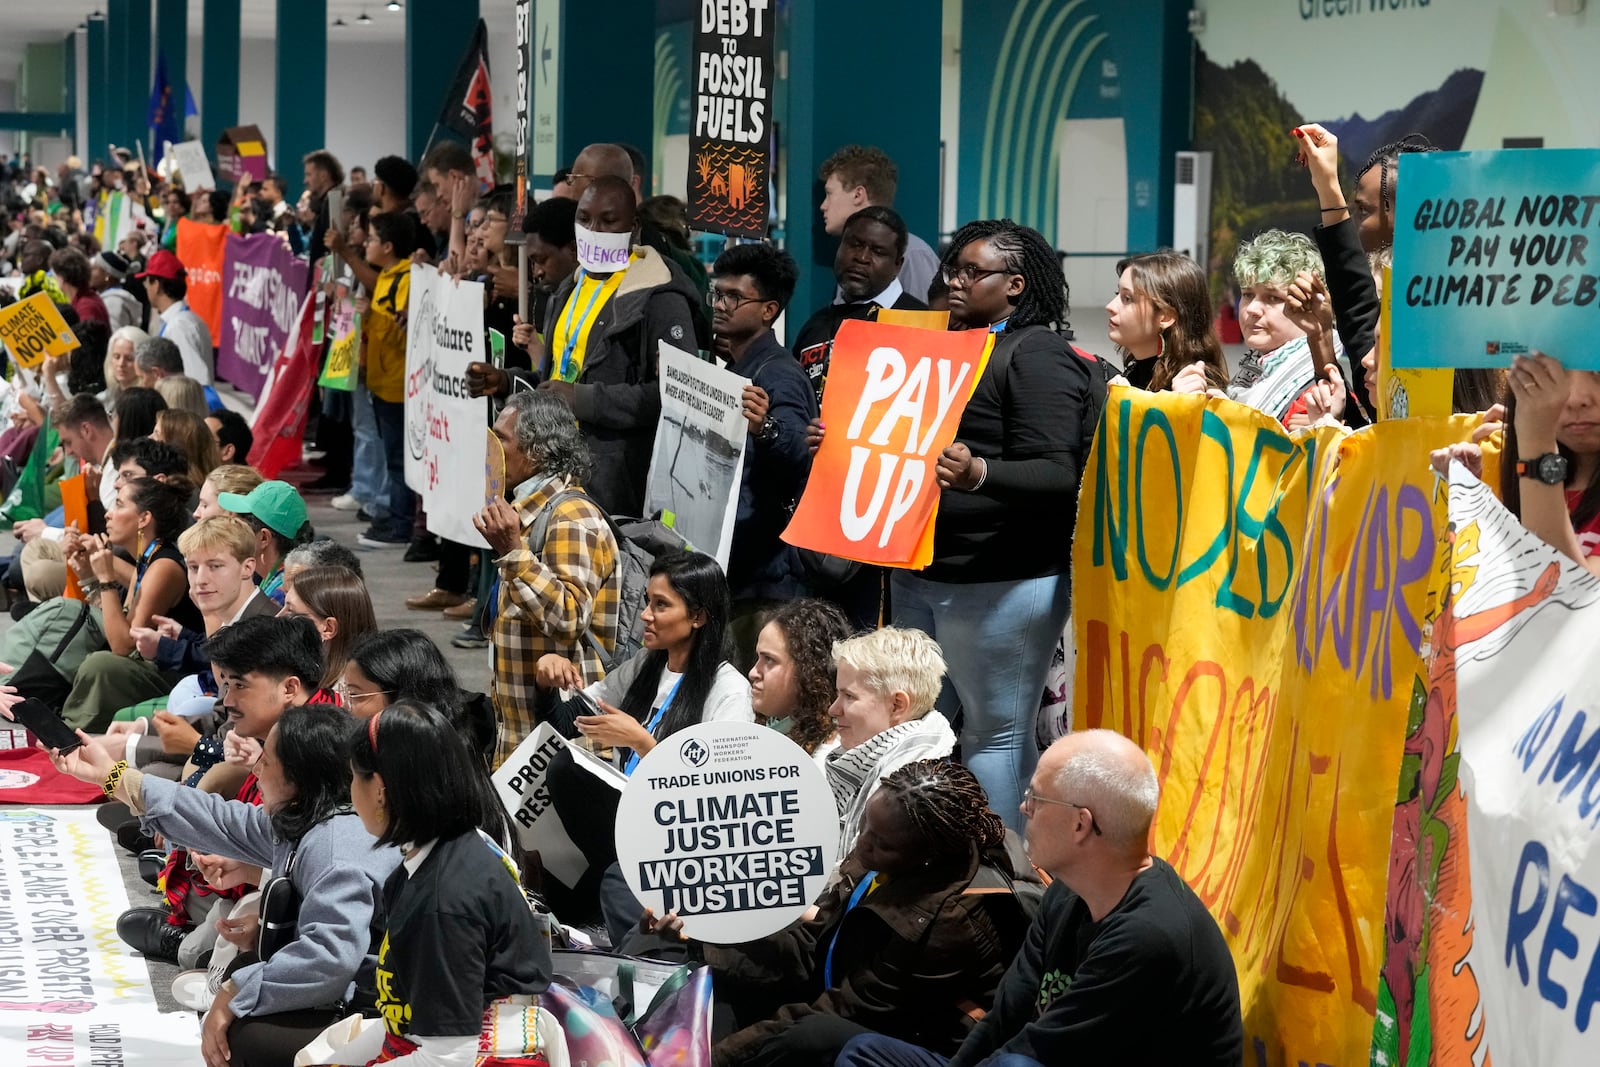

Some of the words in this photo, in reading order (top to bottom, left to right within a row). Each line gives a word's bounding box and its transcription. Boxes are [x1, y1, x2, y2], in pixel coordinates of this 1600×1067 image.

[701, 0, 768, 37] DEBT
[721, 38, 737, 55] TO
[698, 52, 766, 99] FOSSIL
[696, 95, 764, 144] FUELS
[1413, 197, 1506, 231] GLOBAL
[1514, 194, 1600, 229] NORT
[577, 238, 629, 265] SILENCED
[1447, 234, 1500, 268] PAY
[1509, 234, 1588, 267] YOUR
[1406, 273, 1521, 307] CLIMATE
[1530, 273, 1600, 308] DEB
[0, 302, 36, 337] CLIMATE
[12, 311, 45, 344] ACTION
[15, 322, 57, 362] NOW
[847, 347, 971, 456] PAY
[840, 446, 926, 548] UP
[1092, 399, 1182, 592] NO
[712, 735, 760, 743] INTERNATIONAL
[713, 742, 749, 750] TRANSPORT
[714, 755, 752, 763] FEDERATION
[648, 774, 700, 790] TRADE
[703, 768, 765, 785] UNIONS
[769, 765, 800, 780] FOR
[654, 789, 800, 826] CLIMATE
[664, 818, 795, 854] JUSTICE
[669, 878, 801, 914] JUSTICE
[31, 909, 86, 944] OVER
